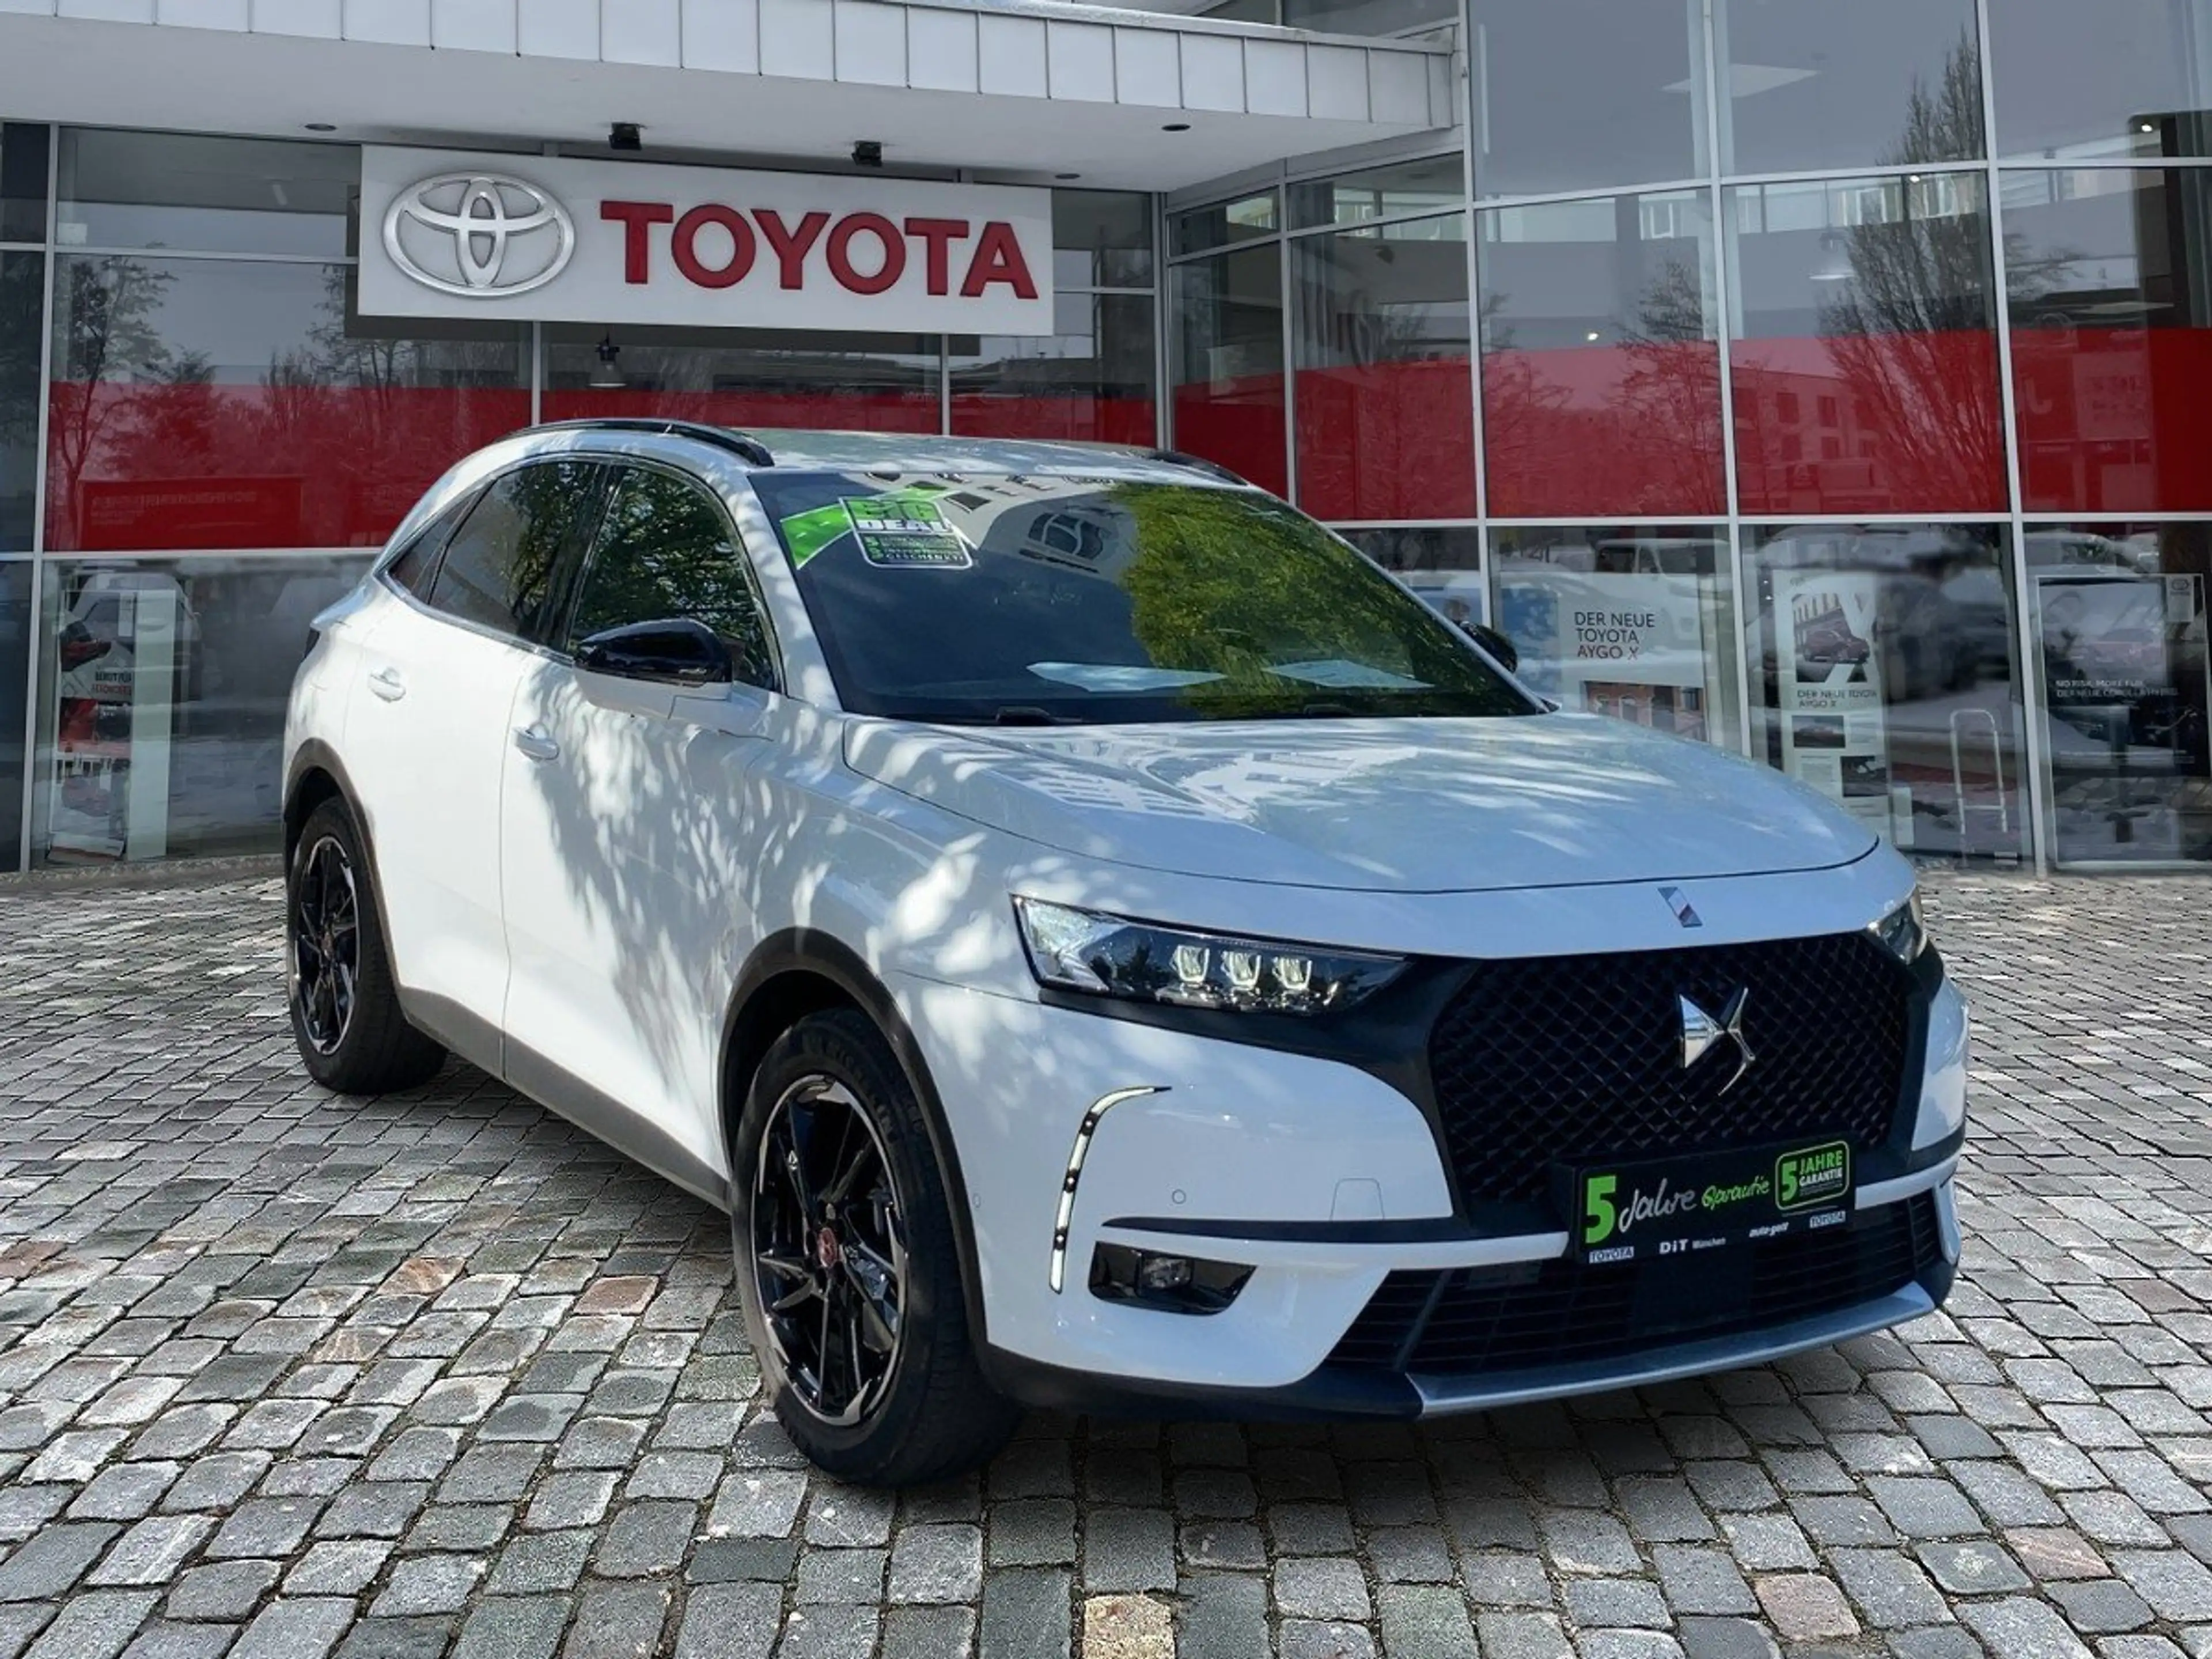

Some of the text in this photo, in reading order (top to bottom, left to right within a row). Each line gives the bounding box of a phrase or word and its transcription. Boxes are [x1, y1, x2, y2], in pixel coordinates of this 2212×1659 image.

[600, 199, 1038, 300] TOYOTA
[1574, 612, 1656, 627] DER NEUE
[1576, 628, 1639, 643] TOYOTA
[1577, 645, 1639, 660] AYGO X
[1800, 1150, 1843, 1175] JAHRE
[1782, 1161, 1797, 1201] 5
[1585, 1176, 1616, 1244] 5
[1618, 1178, 1697, 1233] Jahre
[1660, 1239, 1688, 1254] DiT
[1589, 1247, 1634, 1264] TOYOTA
